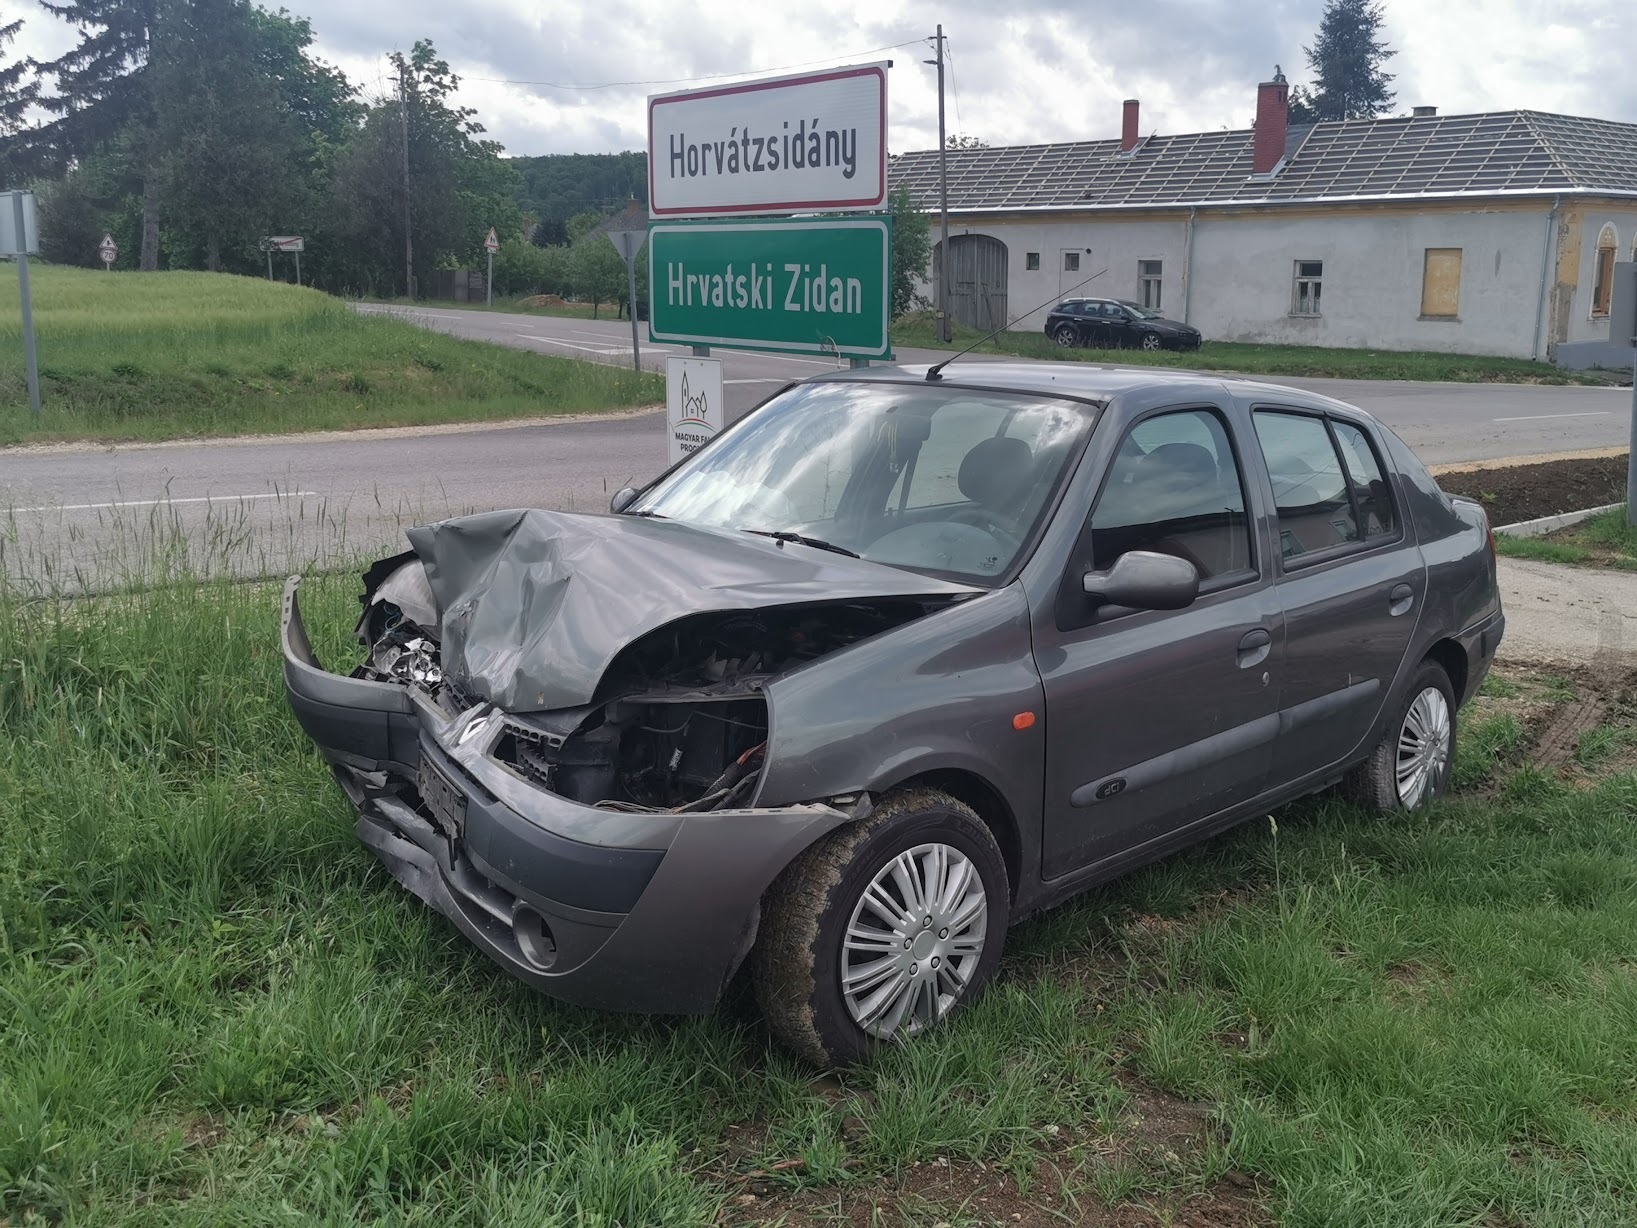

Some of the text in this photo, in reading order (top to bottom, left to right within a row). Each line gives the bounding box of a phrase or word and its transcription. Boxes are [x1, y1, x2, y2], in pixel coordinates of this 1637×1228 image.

[669, 118, 857, 179] Horvátzsidány
[668, 262, 862, 314] Hrvatski Zidan
[675, 432, 700, 443] MAGYAR
